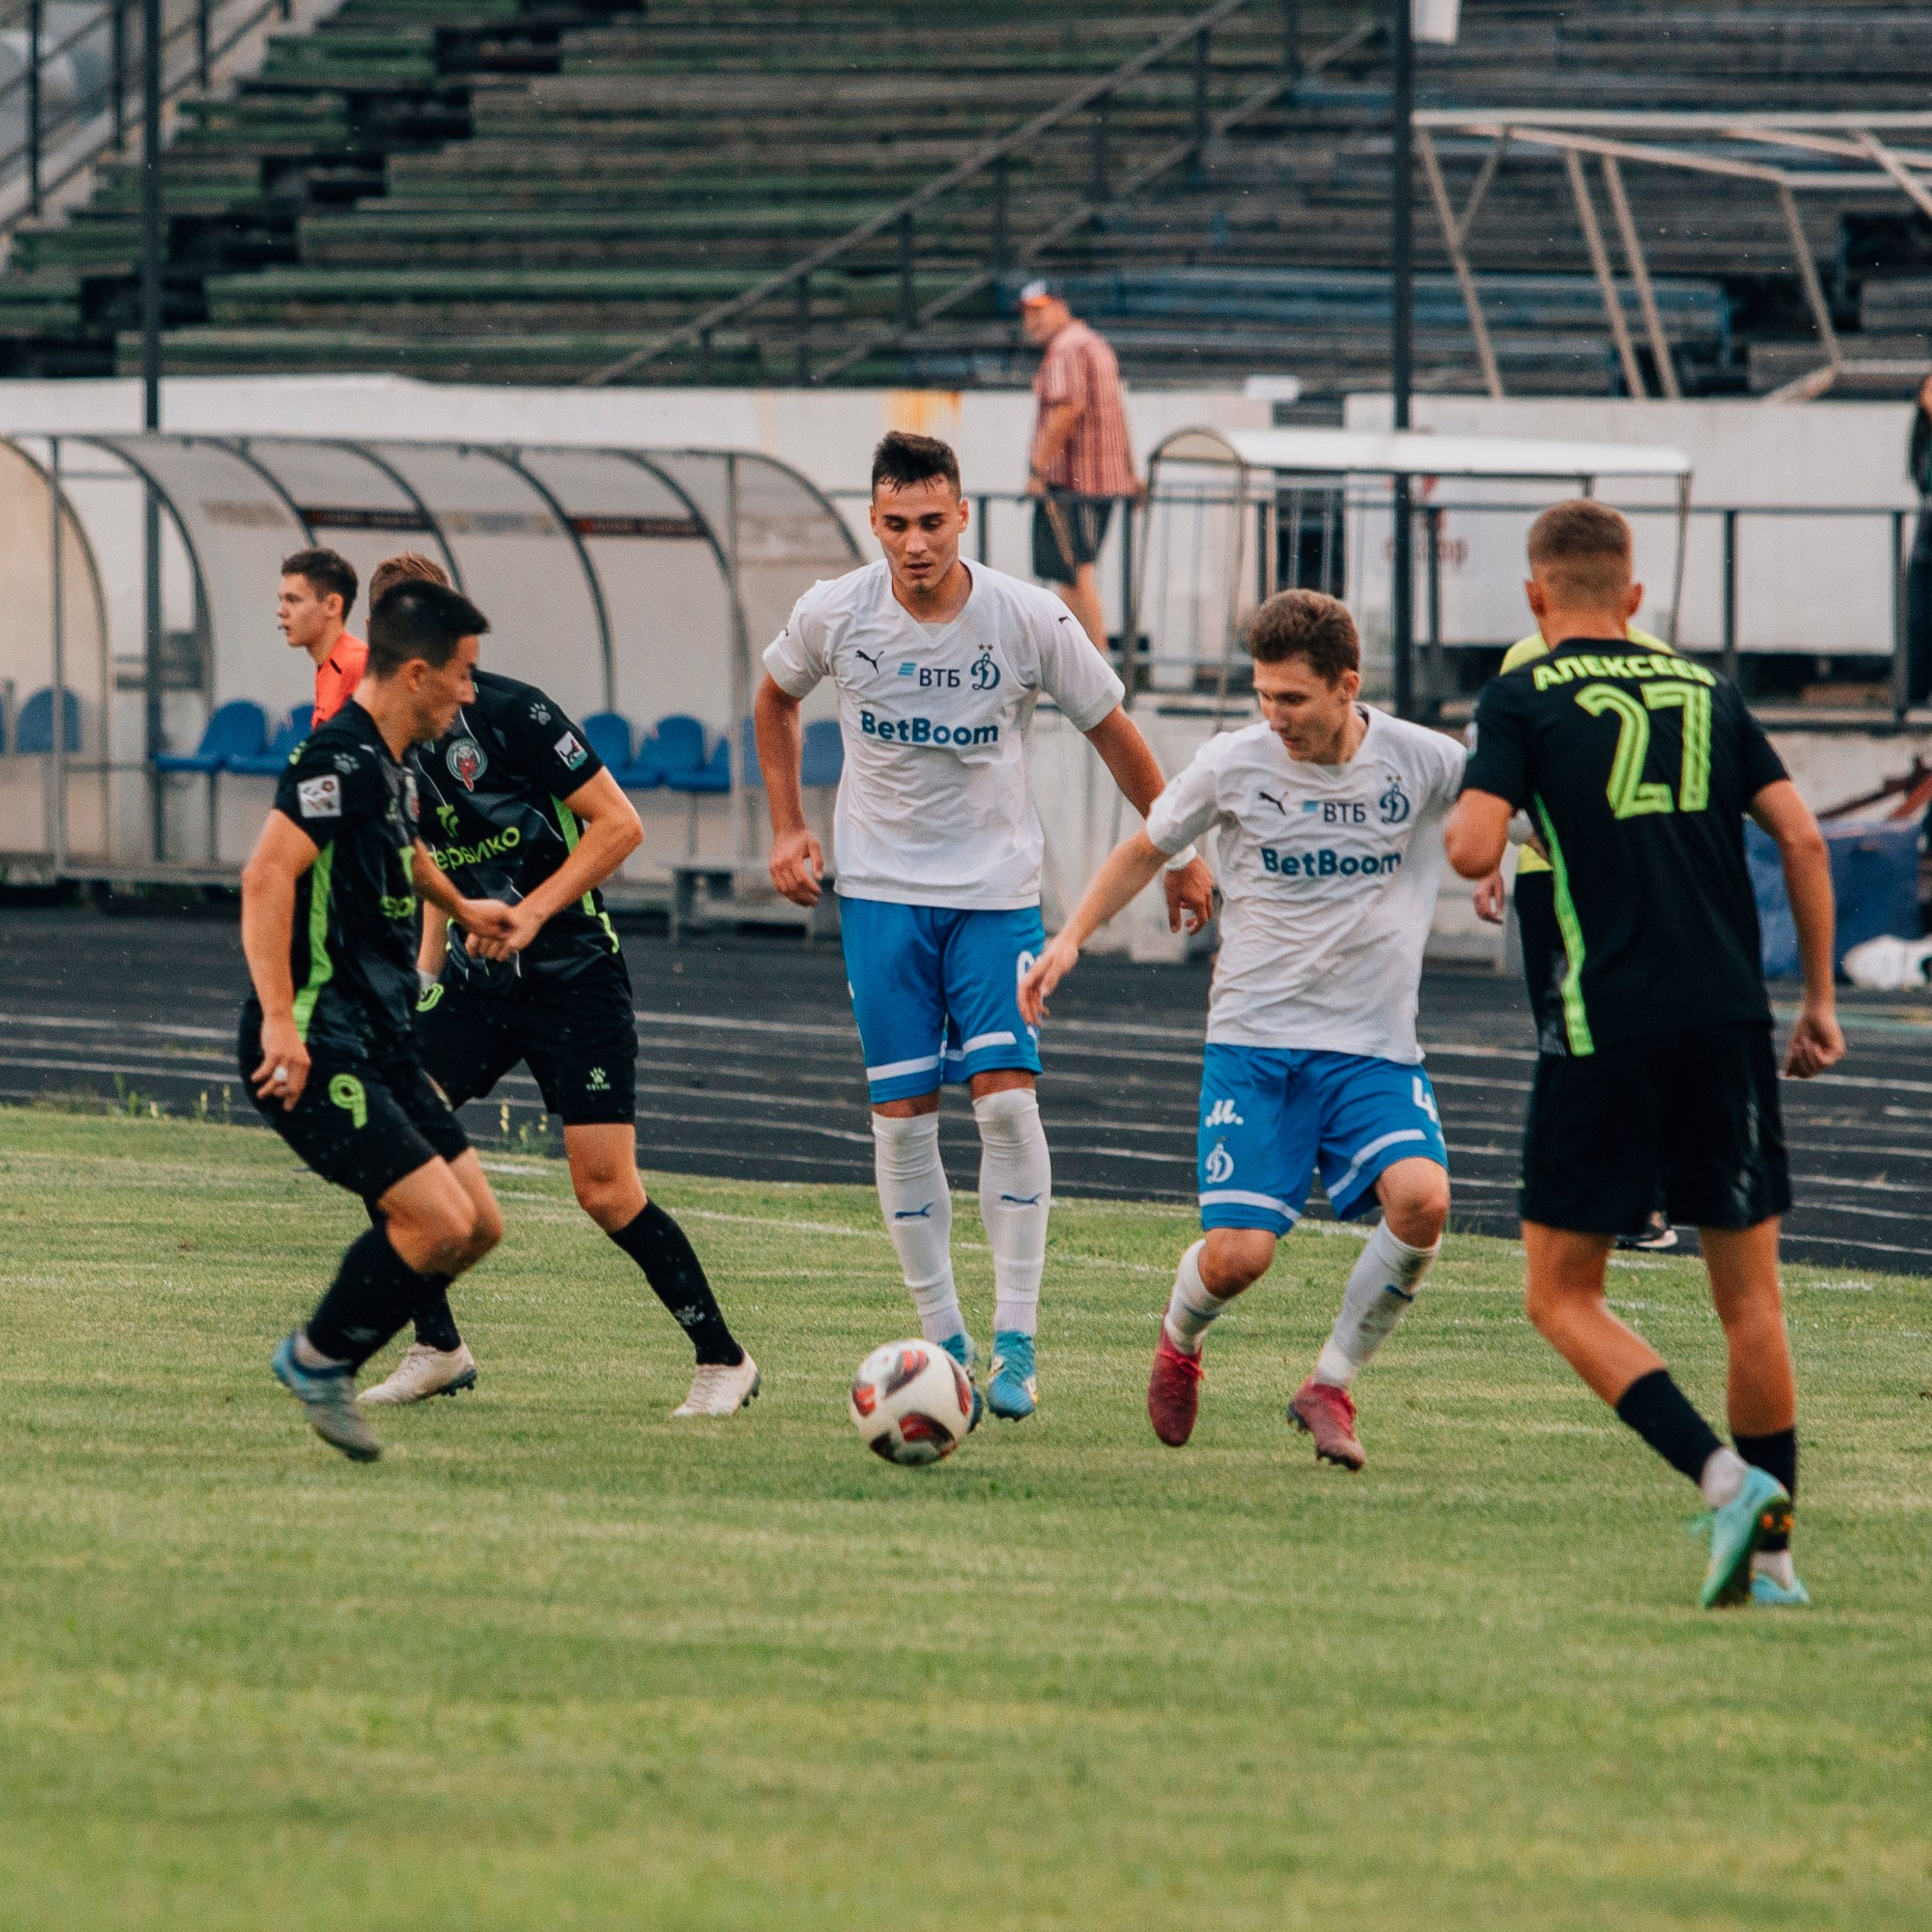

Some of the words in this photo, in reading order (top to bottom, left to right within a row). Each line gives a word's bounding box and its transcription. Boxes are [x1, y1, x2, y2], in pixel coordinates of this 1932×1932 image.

[918, 667, 961, 688] ВТБ
[860, 710, 999, 746] BetBoom
[1574, 681, 1712, 820] 27
[1323, 802, 1367, 823] ВТБ
[427, 826, 521, 871] ервико
[1260, 846, 1402, 877] BetBoom
[328, 1072, 368, 1129] 9
[1412, 1075, 1438, 1124] 4
